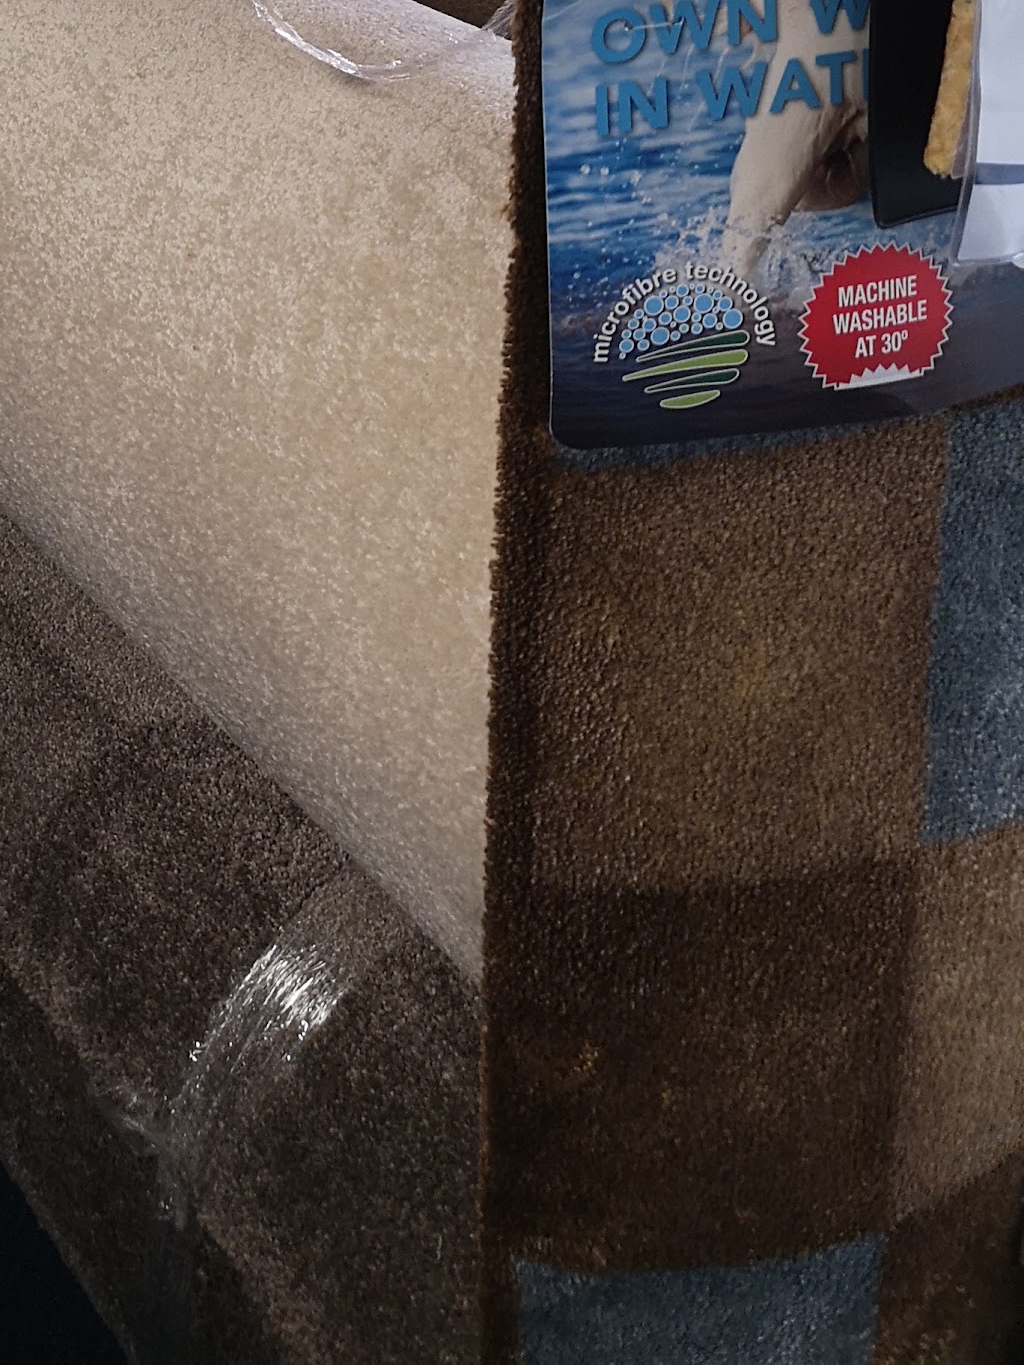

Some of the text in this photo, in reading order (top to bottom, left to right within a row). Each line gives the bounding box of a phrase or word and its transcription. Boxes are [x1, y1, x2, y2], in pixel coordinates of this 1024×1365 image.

[595, 75, 670, 136] IN
[838, 275, 918, 308] MACHINE
[593, 261, 776, 363] microfibre technology
[832, 299, 928, 335] WASHABLE
[854, 334, 877, 358] AT
